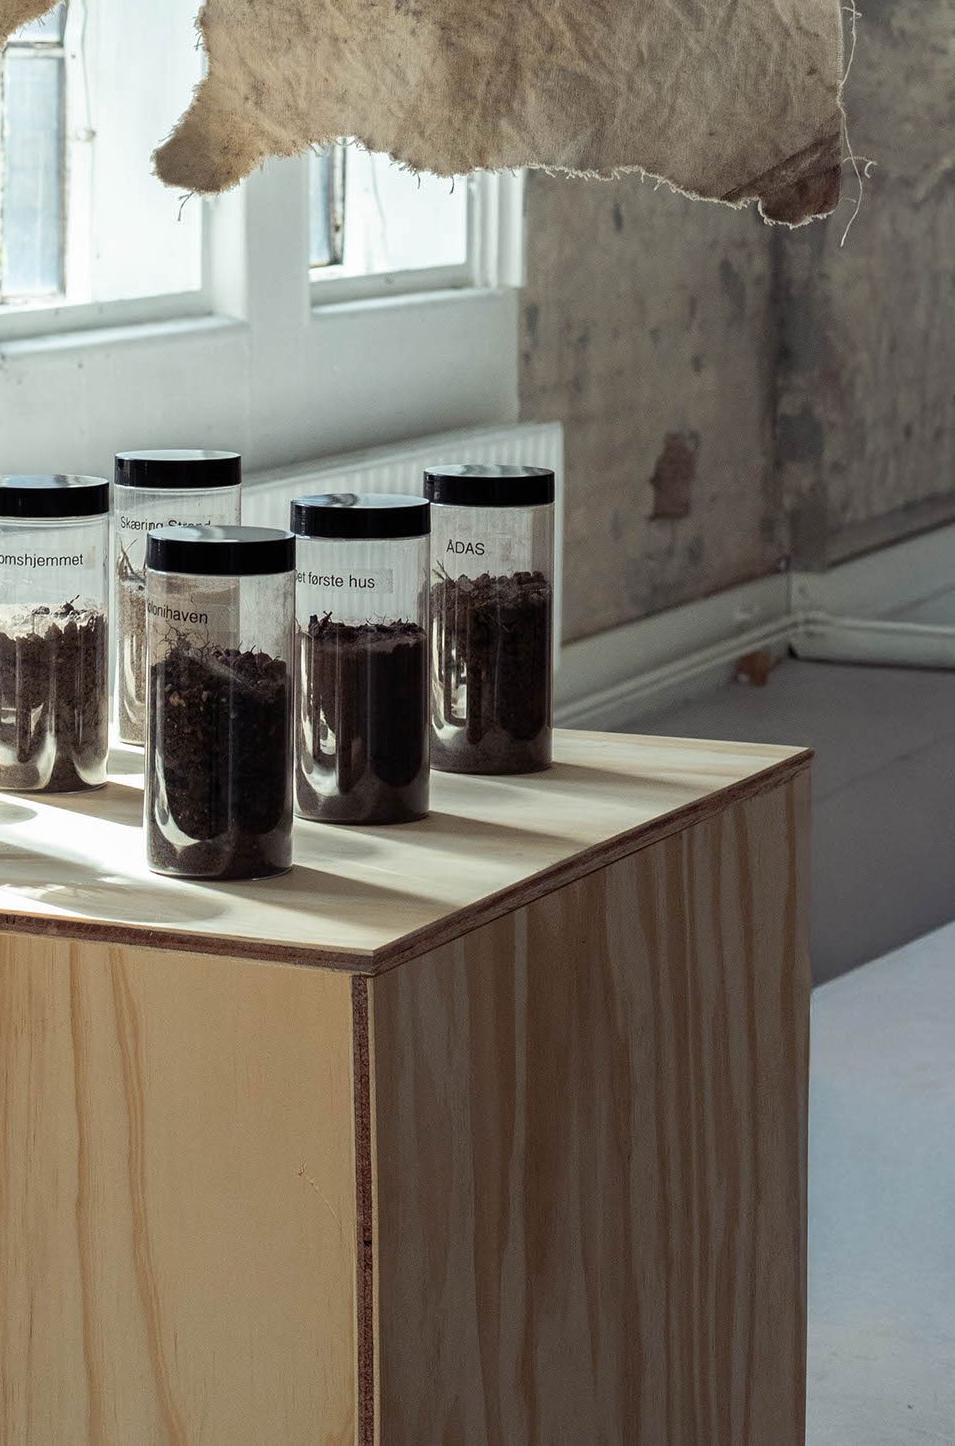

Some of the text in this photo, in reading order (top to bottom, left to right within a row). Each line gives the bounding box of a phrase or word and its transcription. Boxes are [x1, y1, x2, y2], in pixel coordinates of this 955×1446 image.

[446, 539, 485, 555] ÅDAS
[295, 571, 375, 588] et første hus
[147, 601, 208, 624] olonihaven
